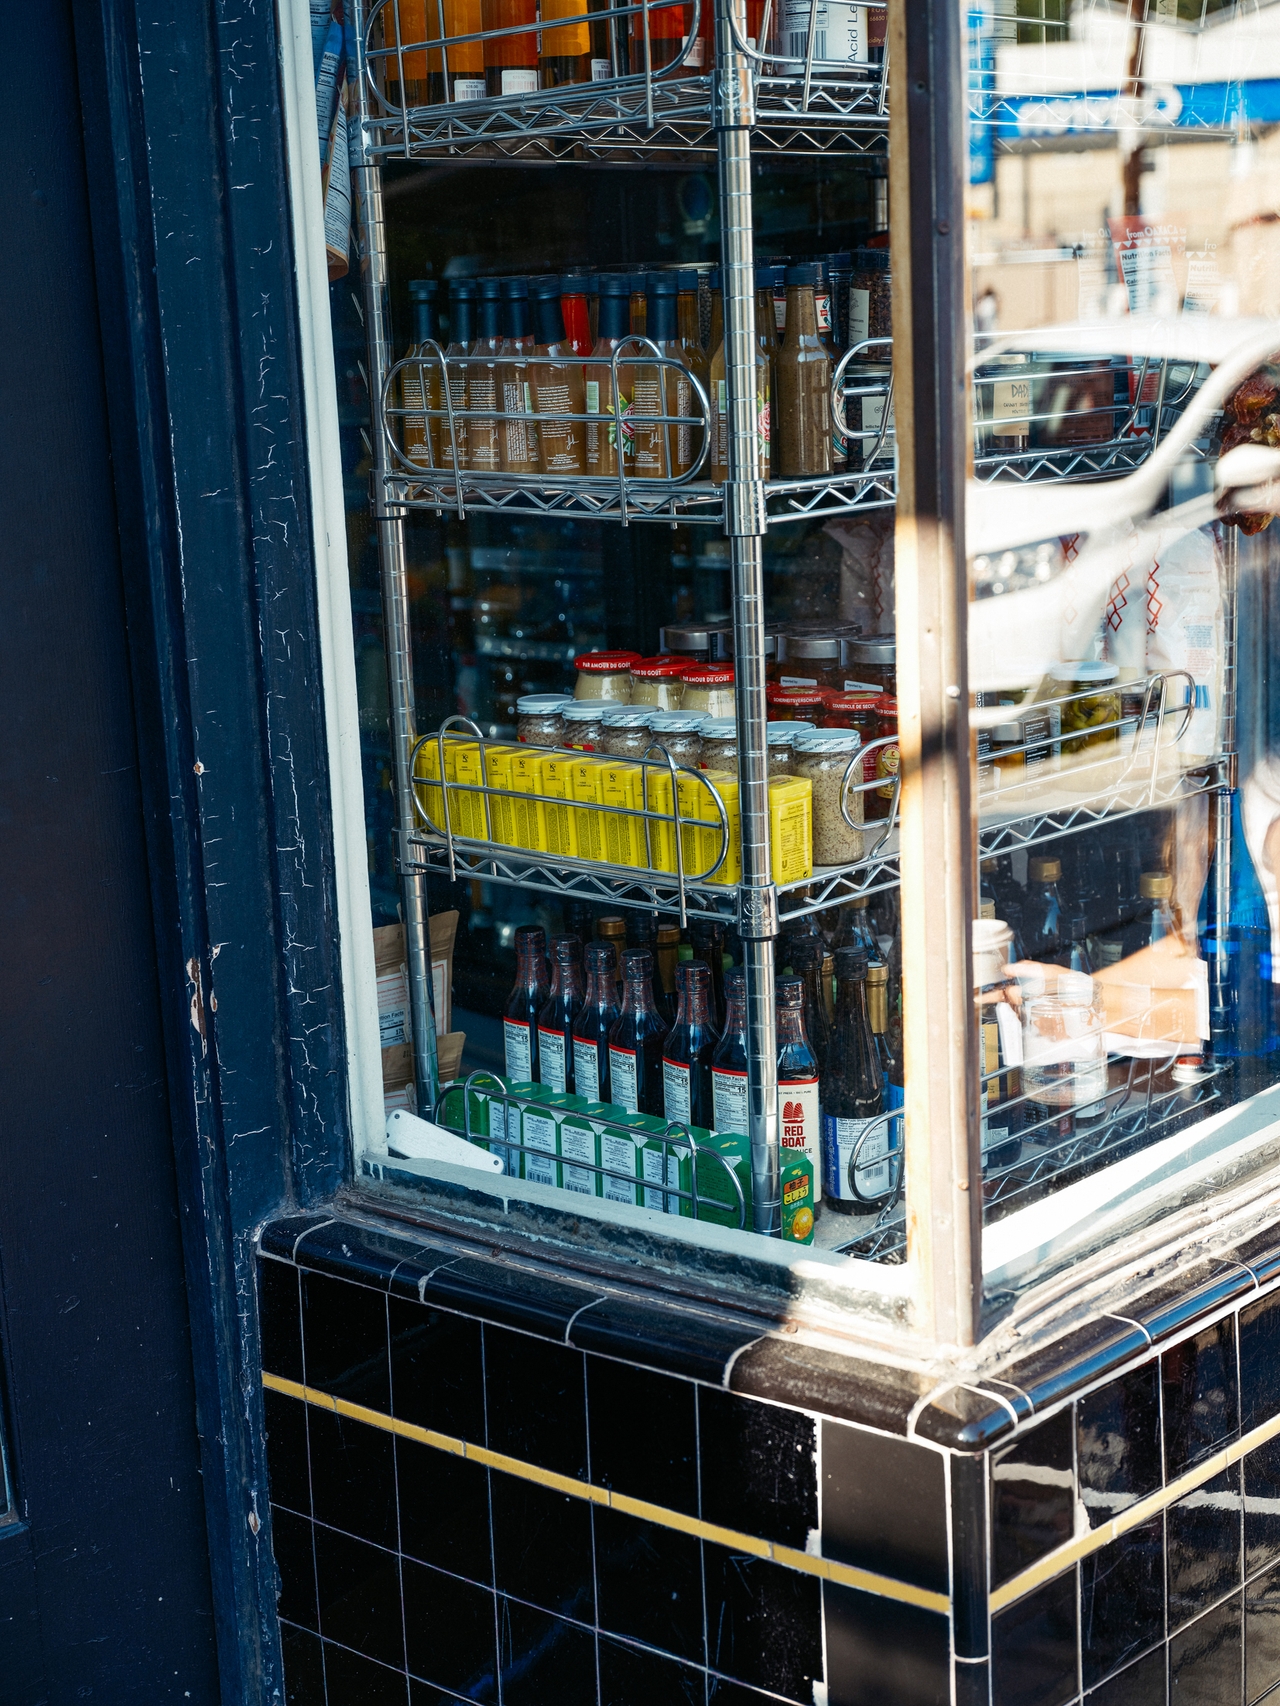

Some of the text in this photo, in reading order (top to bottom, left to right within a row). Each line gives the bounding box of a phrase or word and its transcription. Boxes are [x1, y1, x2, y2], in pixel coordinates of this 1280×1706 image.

[847, 29, 859, 61] Acid
[1126, 228, 1145, 241] from
[1144, 224, 1178, 237] OAXACA
[1121, 250, 1154, 261] Nutrition
[647, 669, 661, 677] GOÛT
[714, 674, 729, 683] GOÛT
[681, 1078, 689, 1086] 15
[784, 1125, 804, 1136] RED
[781, 1136, 806, 1147] BOAT
[785, 1186, 807, 1203] こしょう
